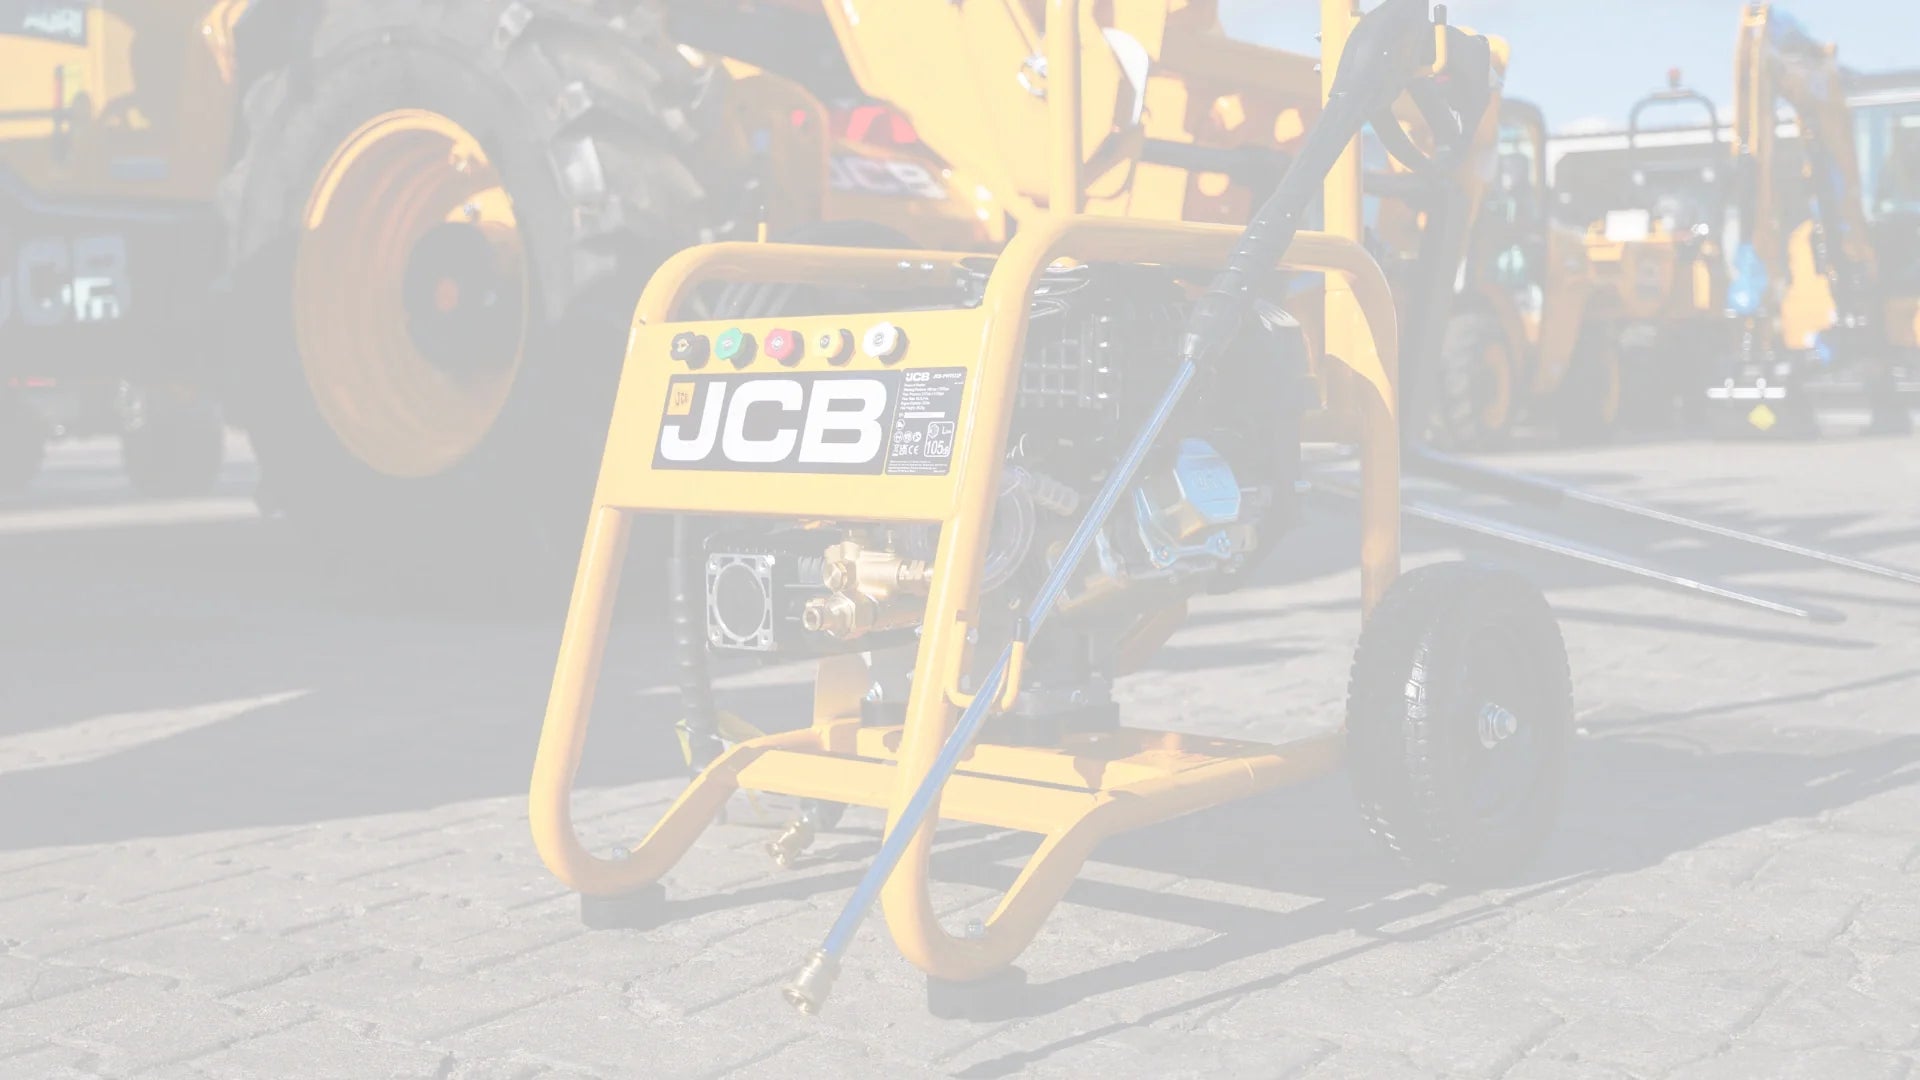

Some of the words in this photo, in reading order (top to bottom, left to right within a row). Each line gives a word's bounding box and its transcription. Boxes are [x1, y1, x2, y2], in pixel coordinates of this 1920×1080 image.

[905, 372, 930, 381] JCB
[675, 392, 689, 406] JCB
[660, 379, 887, 463] JCB
